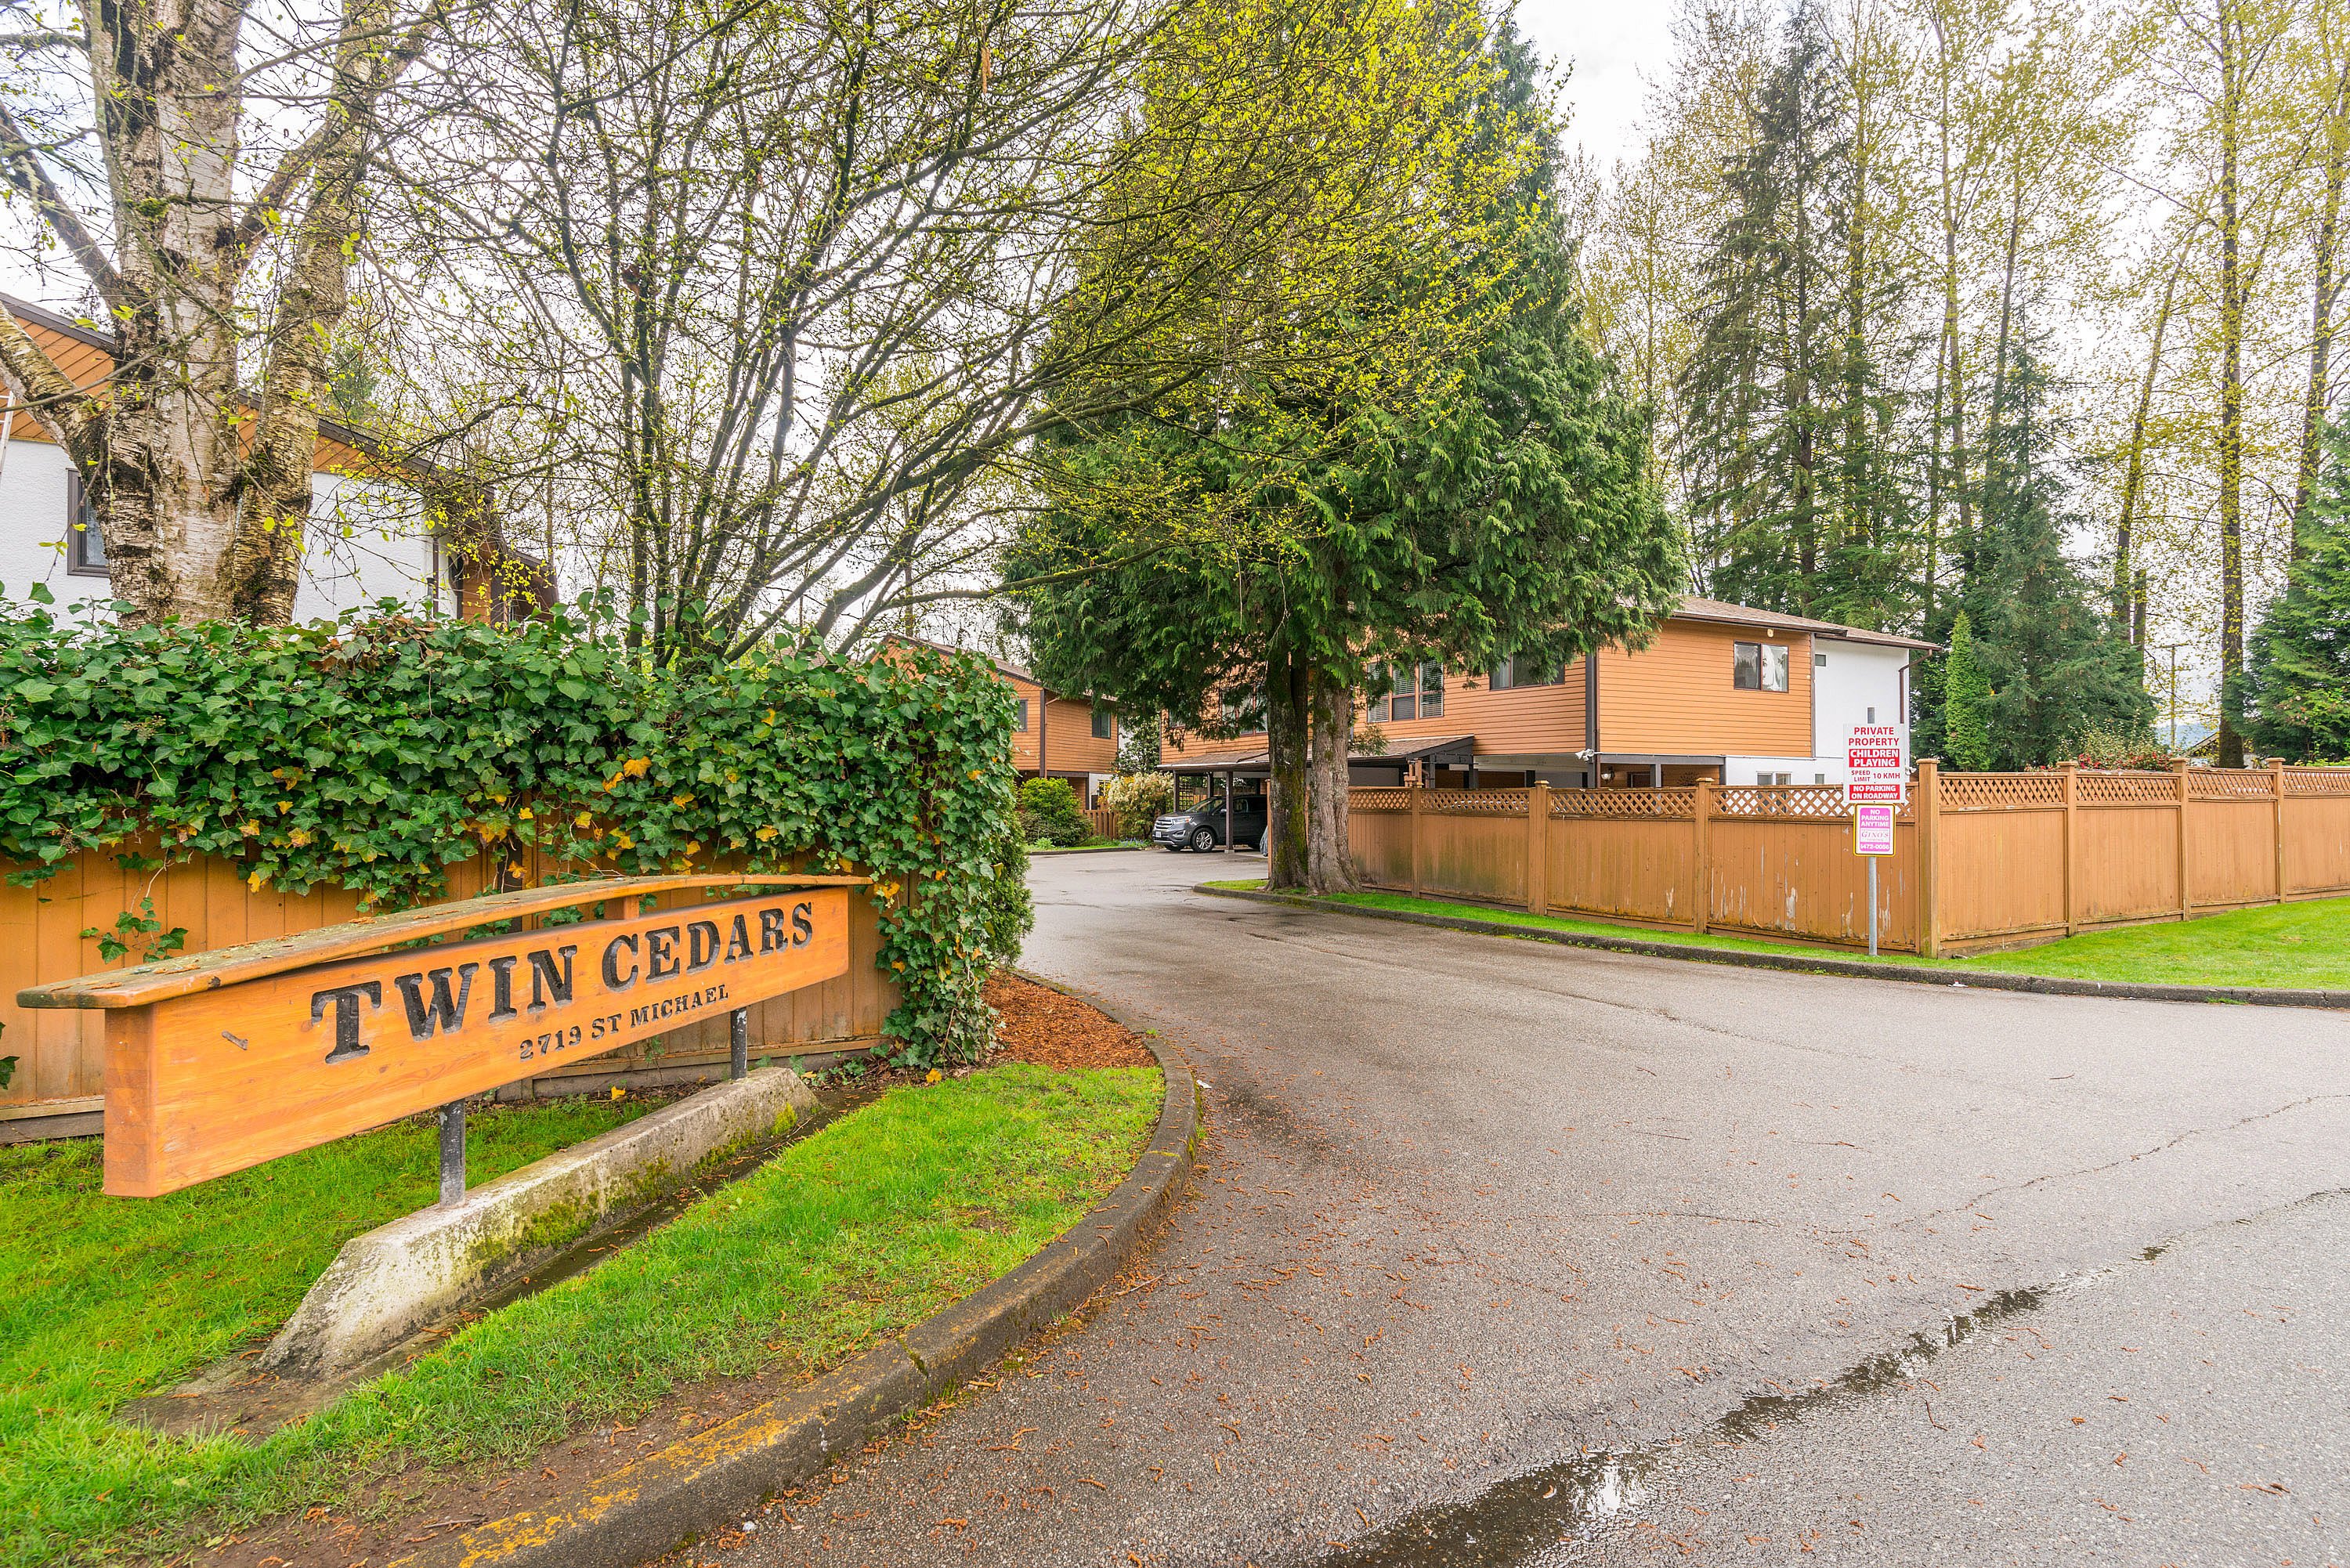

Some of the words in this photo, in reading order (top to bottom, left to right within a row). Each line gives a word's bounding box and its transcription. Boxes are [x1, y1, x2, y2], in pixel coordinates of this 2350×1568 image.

[1850, 750, 1899, 758] CHILDREN
[1853, 758, 1896, 767] PLAYING
[311, 945, 578, 1064] TWIN
[602, 901, 813, 993] CEDARS
[519, 1025, 581, 1060] 2719
[591, 1013, 622, 1041] ST
[630, 985, 728, 1028] MICHAEL
